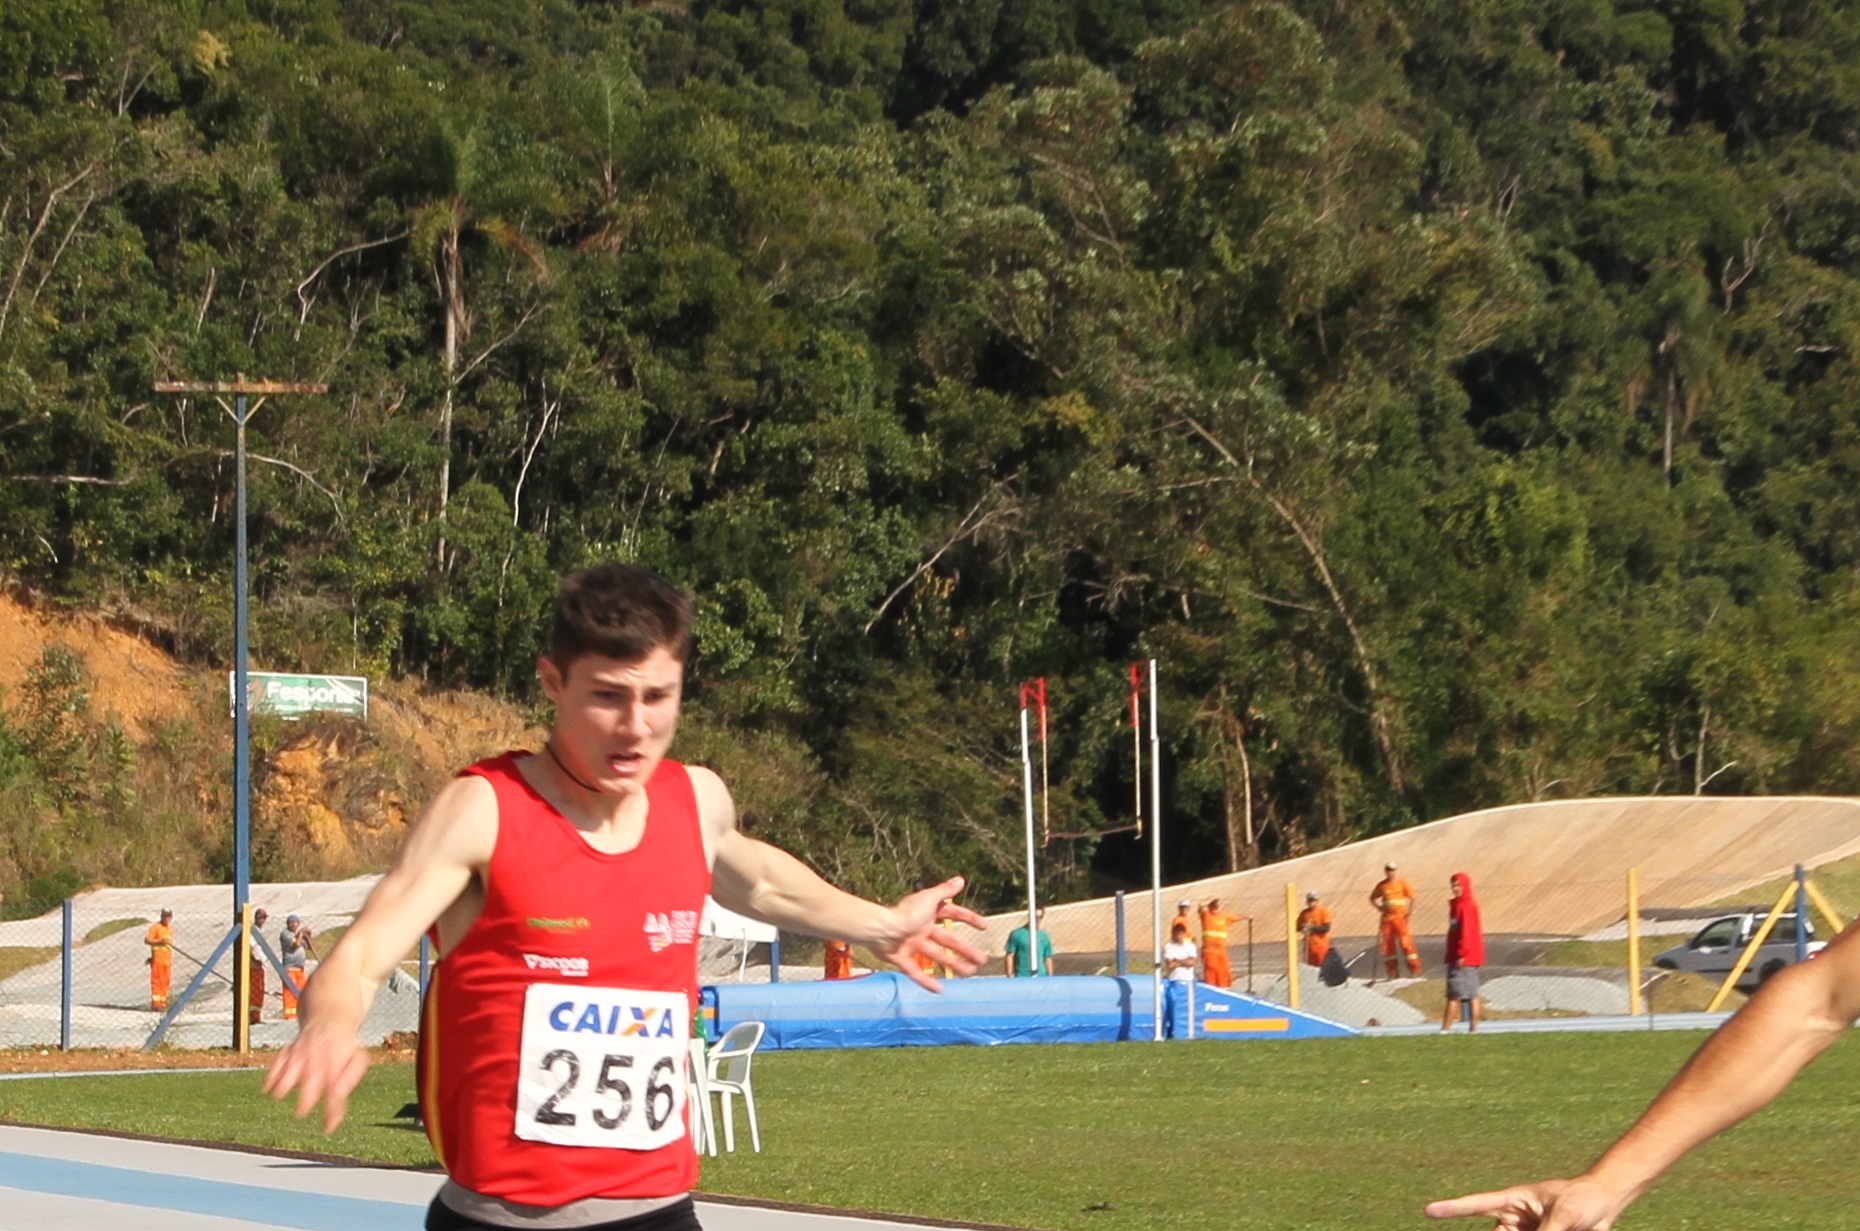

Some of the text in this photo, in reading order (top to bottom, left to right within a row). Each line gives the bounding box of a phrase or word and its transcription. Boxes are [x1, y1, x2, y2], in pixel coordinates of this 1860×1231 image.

[267, 681, 356, 706] Fesporte
[548, 1001, 675, 1038] CAIXA
[535, 1048, 676, 1132] 256
